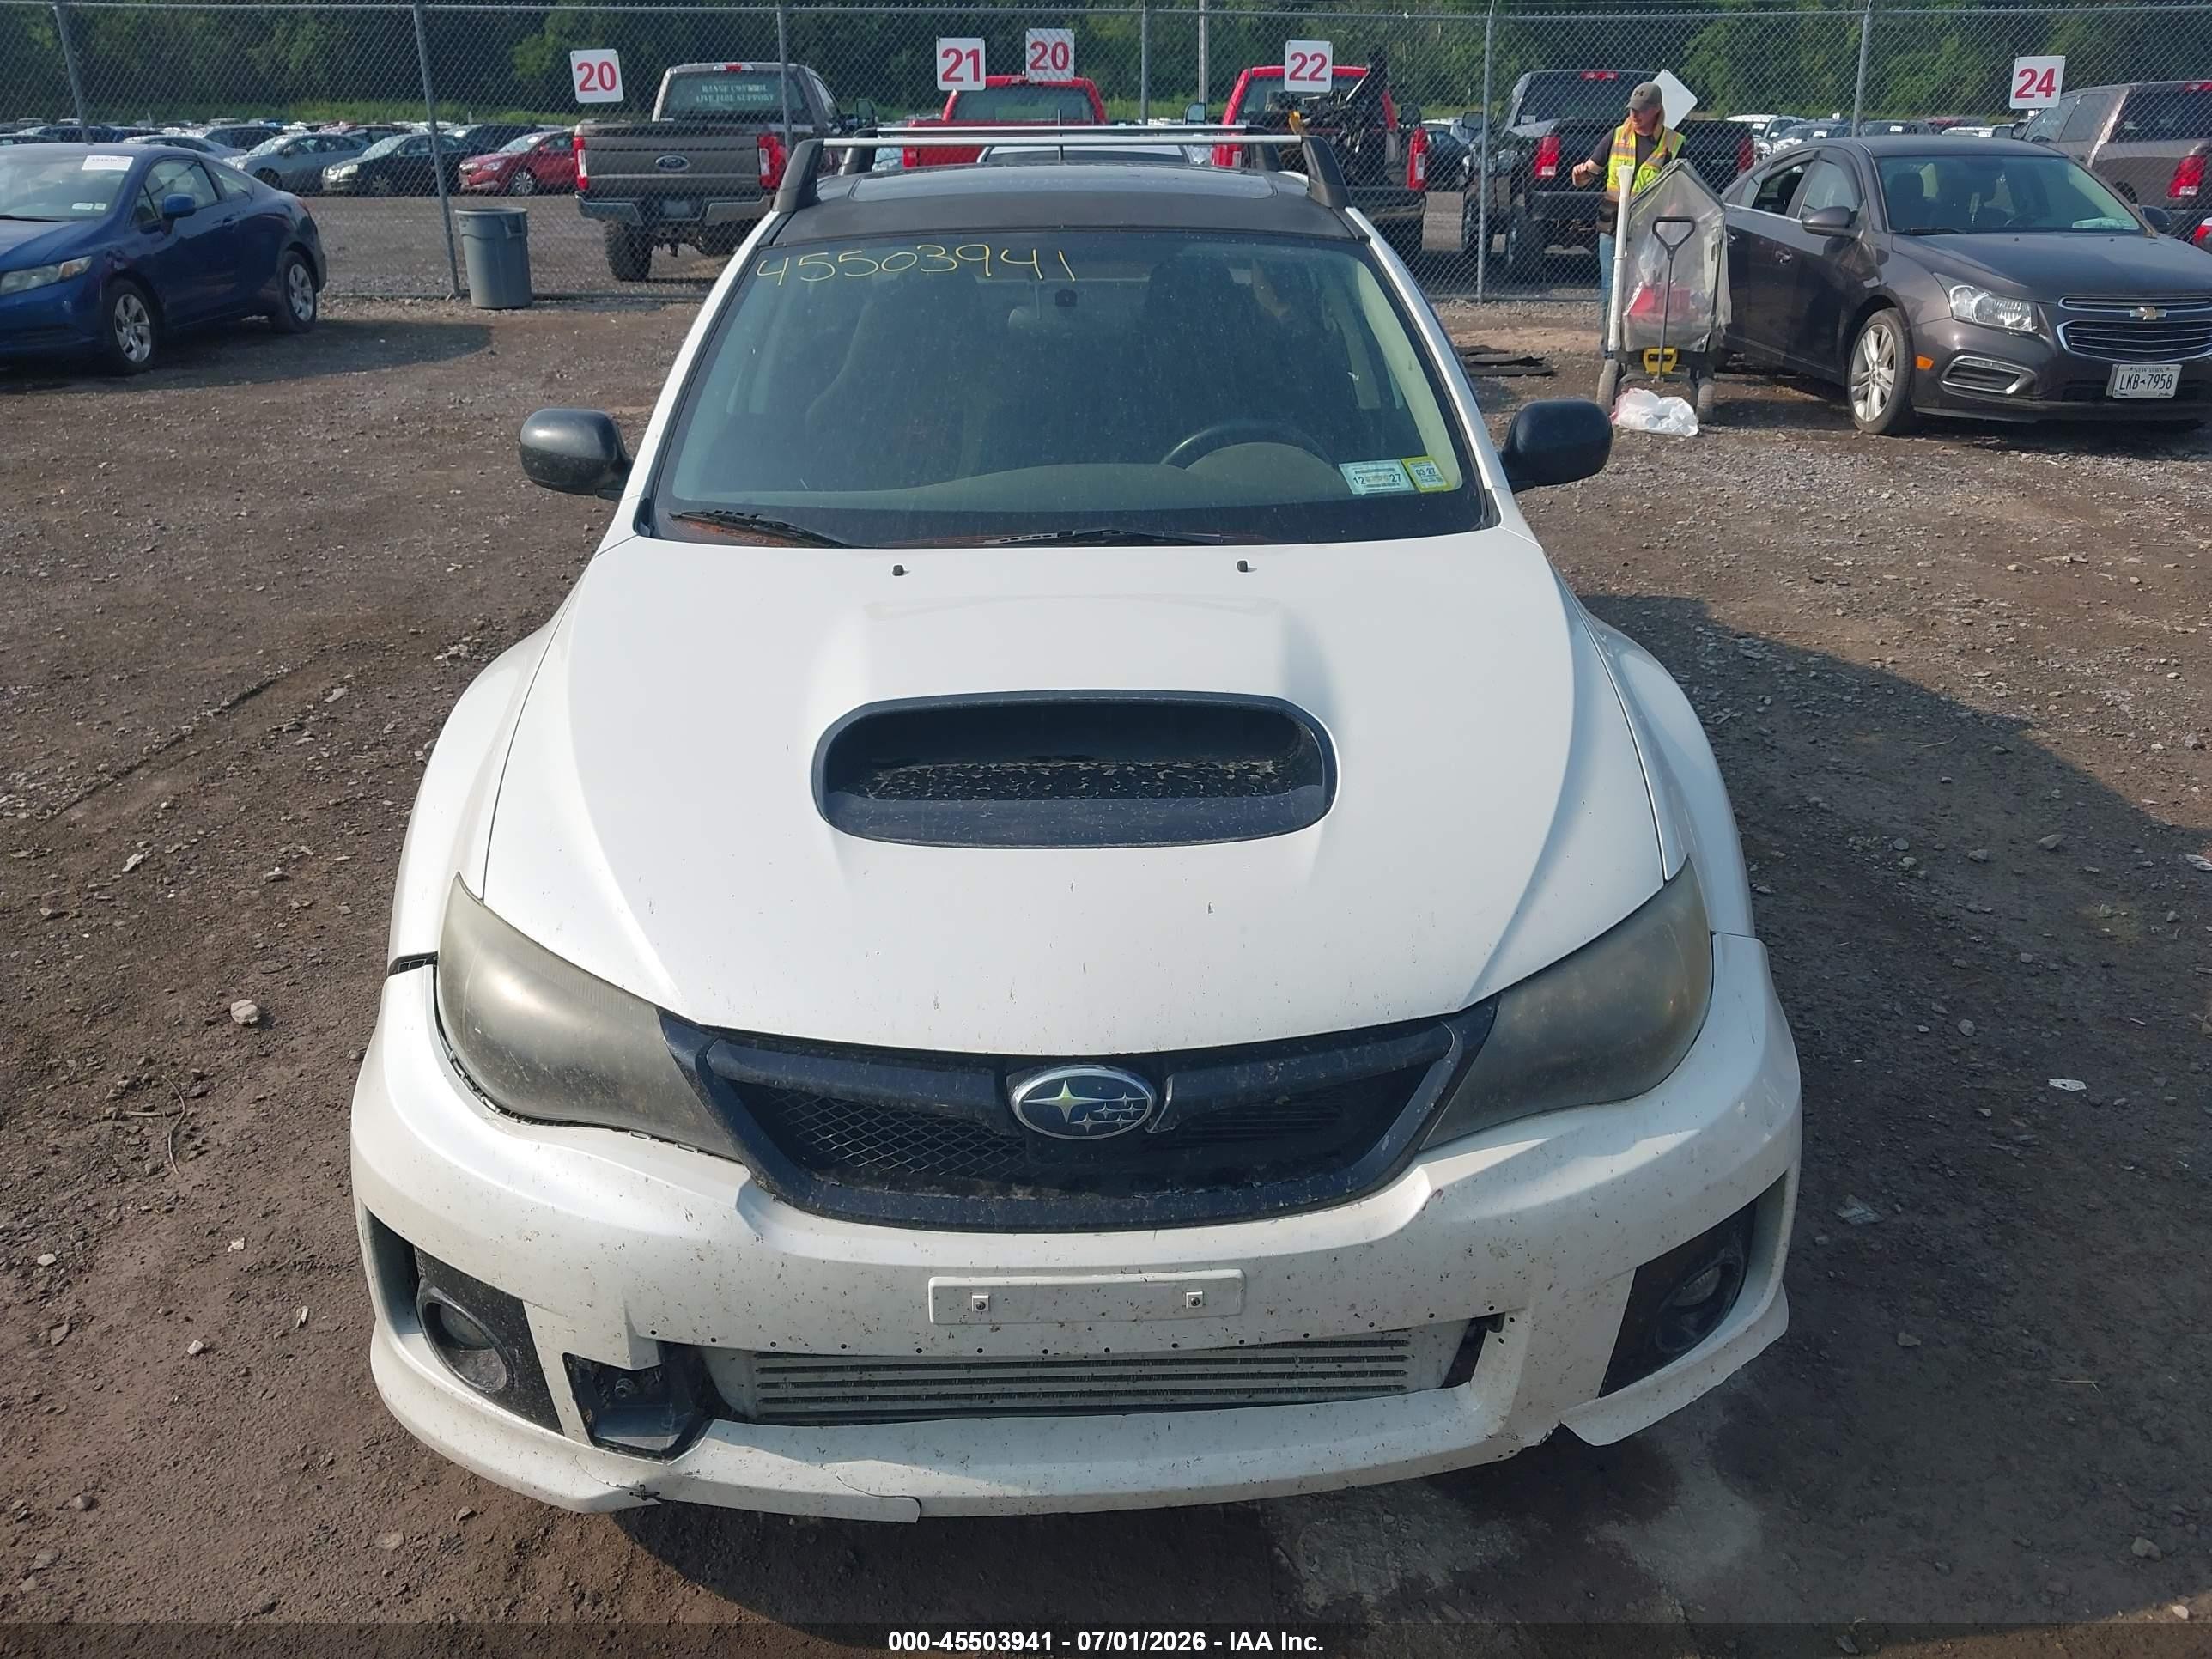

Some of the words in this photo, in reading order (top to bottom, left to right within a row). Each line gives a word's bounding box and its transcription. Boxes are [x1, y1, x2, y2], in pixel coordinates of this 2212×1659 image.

[941, 48, 980, 82] 21
[1030, 41, 1069, 70] 20
[1289, 52, 1327, 82] 22
[576, 61, 617, 92] 20
[2014, 68, 2056, 99] 24
[756, 244, 1076, 287] 45503941
[1352, 476, 1367, 486] 12
[1389, 473, 1401, 483] 27
